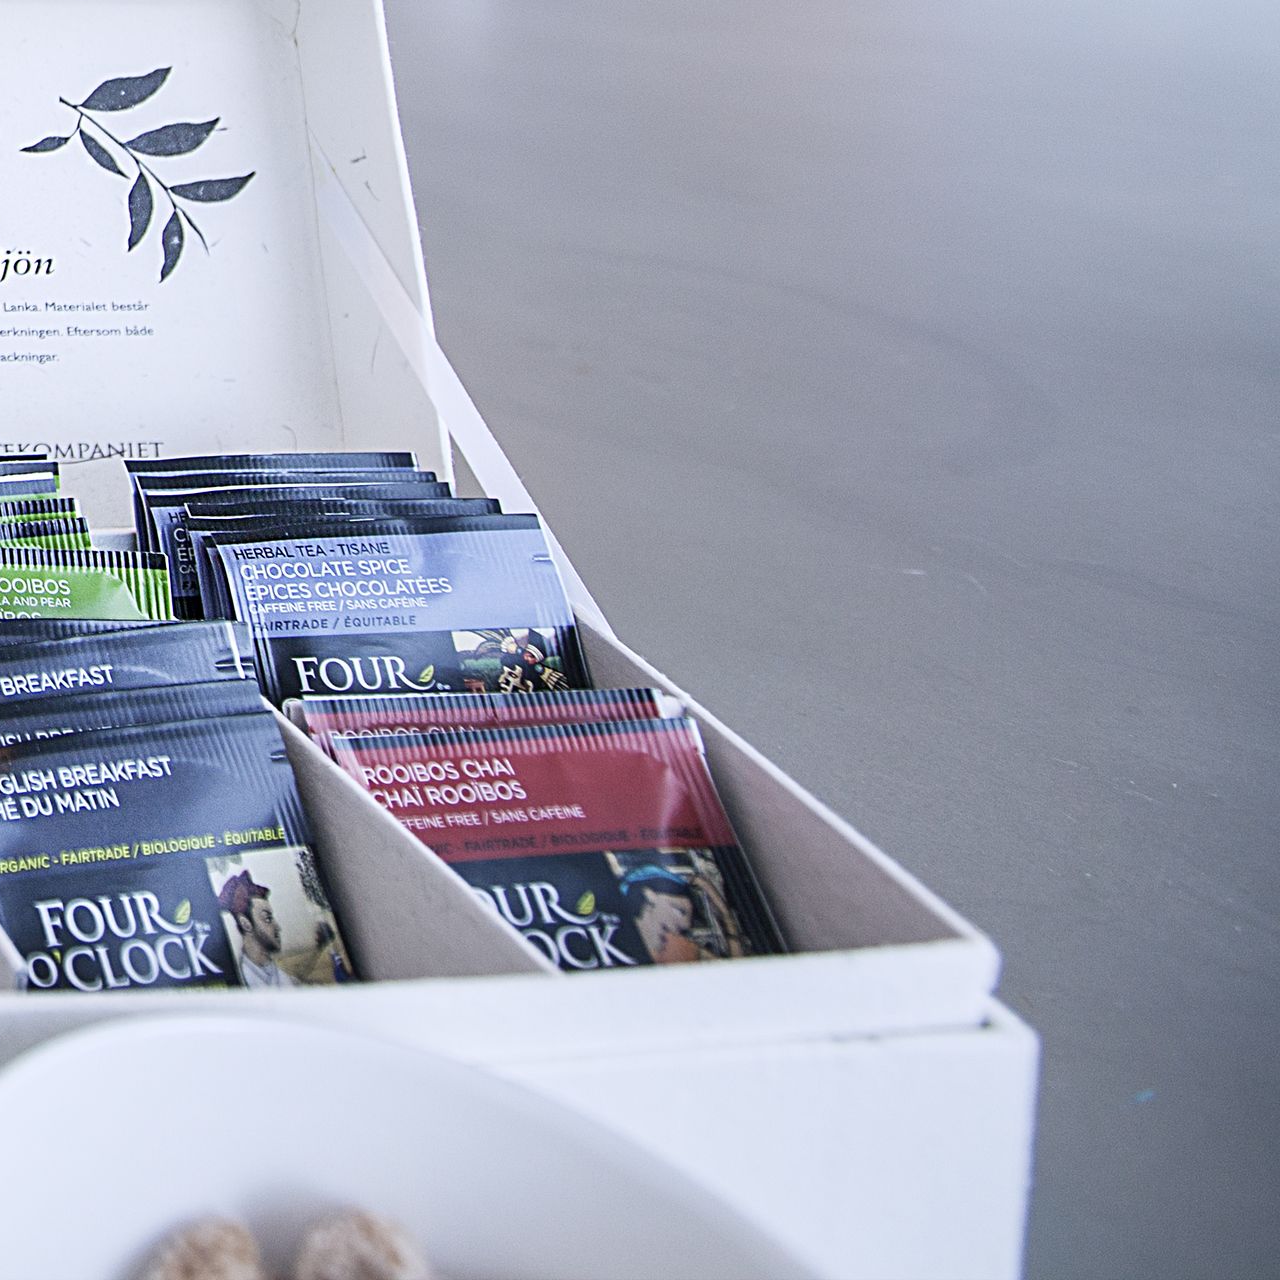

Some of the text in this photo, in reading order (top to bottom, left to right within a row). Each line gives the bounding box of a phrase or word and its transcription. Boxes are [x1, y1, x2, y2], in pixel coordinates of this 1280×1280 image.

[3, 302, 42, 313] Lanka.
[44, 302, 108, 312] Materialet
[111, 300, 150, 312] består
[66, 326, 122, 337] Eftersom
[125, 325, 155, 336] både
[232, 545, 295, 561] HERBAL
[296, 545, 326, 559] TEA
[338, 542, 391, 557] TISANE
[239, 558, 412, 581] CHOCOLATE SPICE
[12, 596, 38, 607] AND
[41, 597, 72, 609] PEAR
[245, 576, 453, 602] ÉPICES CHOCOLATÉES
[248, 601, 306, 616] CAFFEINE
[307, 600, 337, 612] FREE
[346, 599, 377, 610] SANS
[378, 596, 428, 609] CAFÉINE
[252, 618, 328, 633] FAIRTRADE
[343, 615, 417, 629] ÉQUITABLE
[0, 664, 114, 697] BREAKFAST
[291, 655, 436, 693] FOUR
[57, 755, 173, 789] BREAKFAST
[361, 757, 516, 785] ROOIBOS CHAI
[20, 794, 53, 819] DU
[54, 787, 121, 815] MATIN
[371, 779, 528, 810] CHAÏ ROOÏBOS
[446, 812, 482, 827] FREE
[491, 808, 529, 824] SANS
[61, 845, 131, 866] FAIRTRADE
[141, 835, 216, 857] BIOLOGIQUE
[223, 825, 286, 847] ÉQUITABLE
[34, 890, 194, 948] FOUR
[26, 933, 224, 992] O'CLOCK
